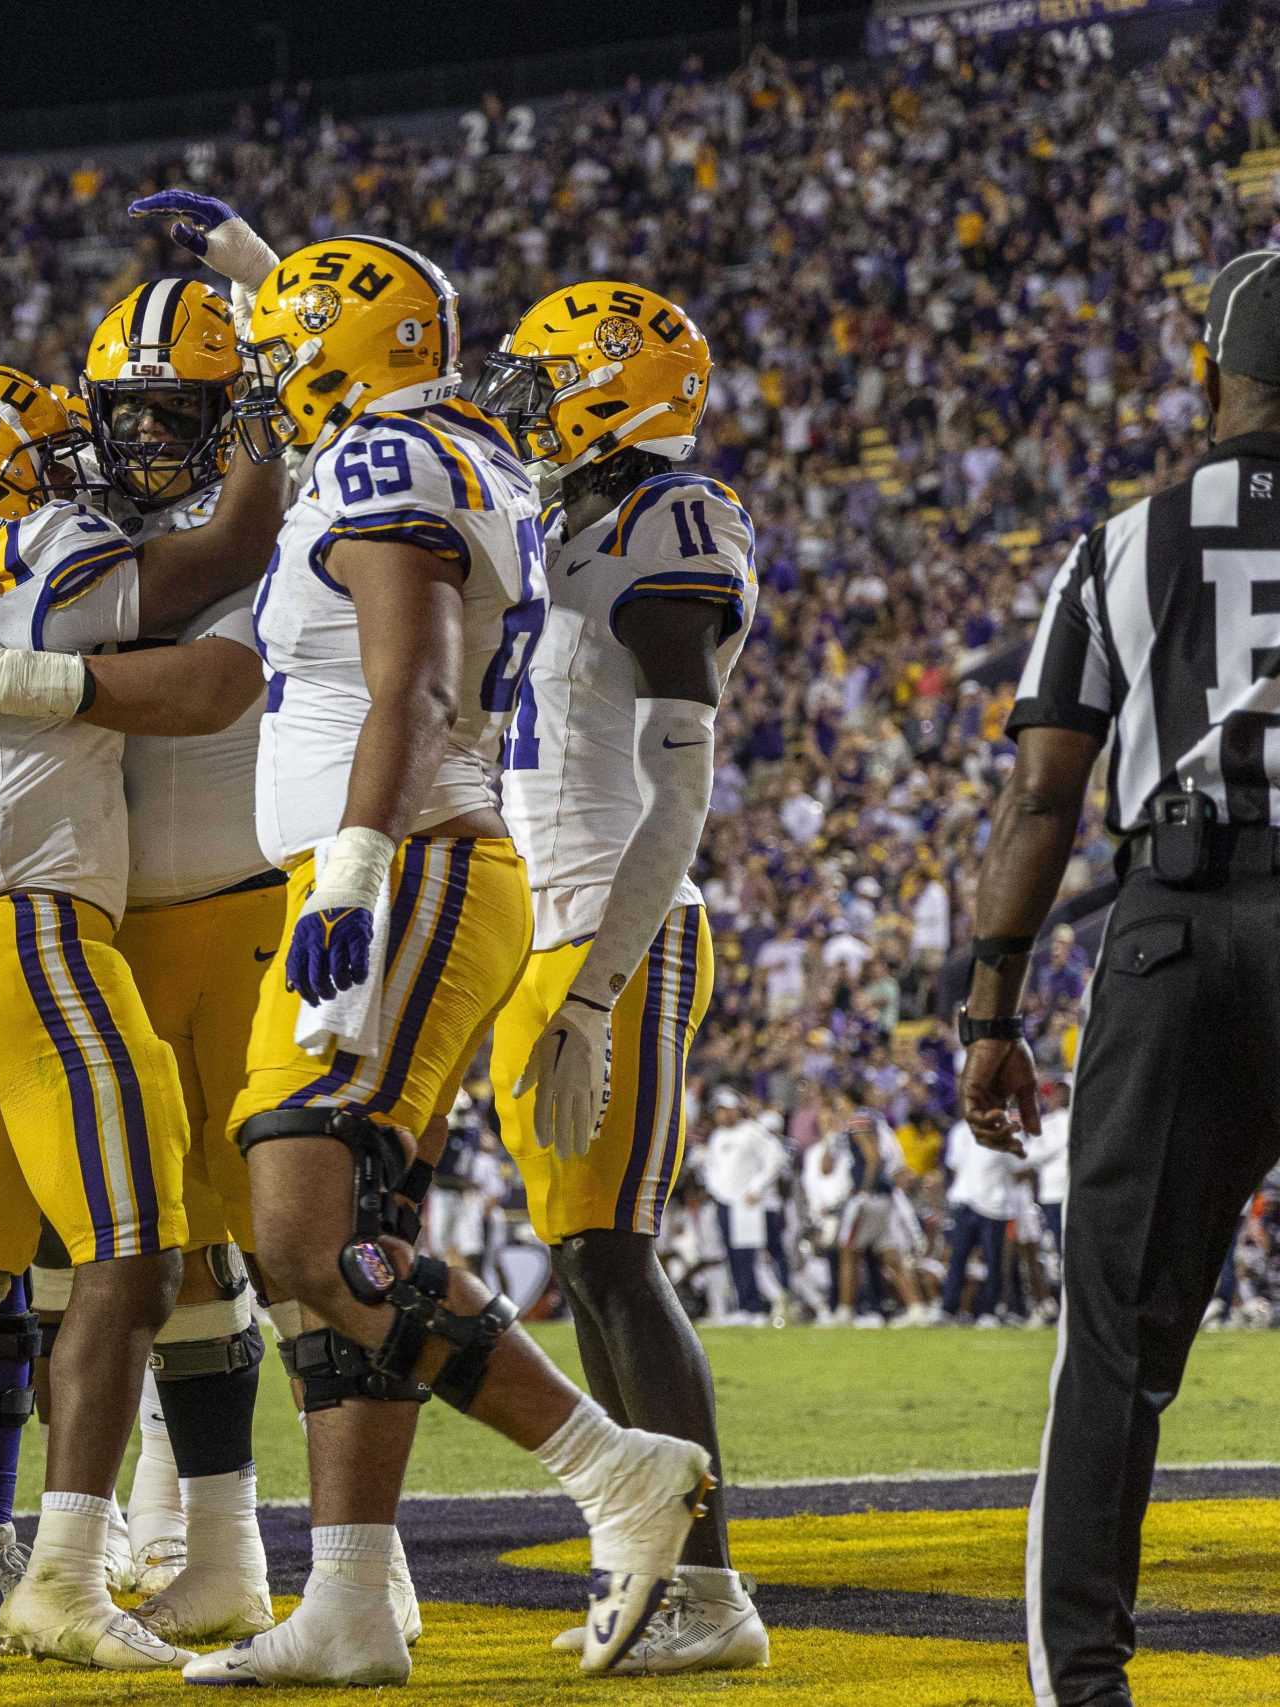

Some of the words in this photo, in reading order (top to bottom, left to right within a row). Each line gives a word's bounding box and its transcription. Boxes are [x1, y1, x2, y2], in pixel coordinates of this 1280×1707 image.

[460, 105, 536, 156] 22
[277, 252, 395, 302] LSU
[404, 322, 416, 342] 3
[564, 290, 686, 344] LSU
[132, 364, 164, 378] LSU
[687, 376, 696, 395] 3
[334, 438, 413, 506] 69
[671, 500, 719, 557] 11
